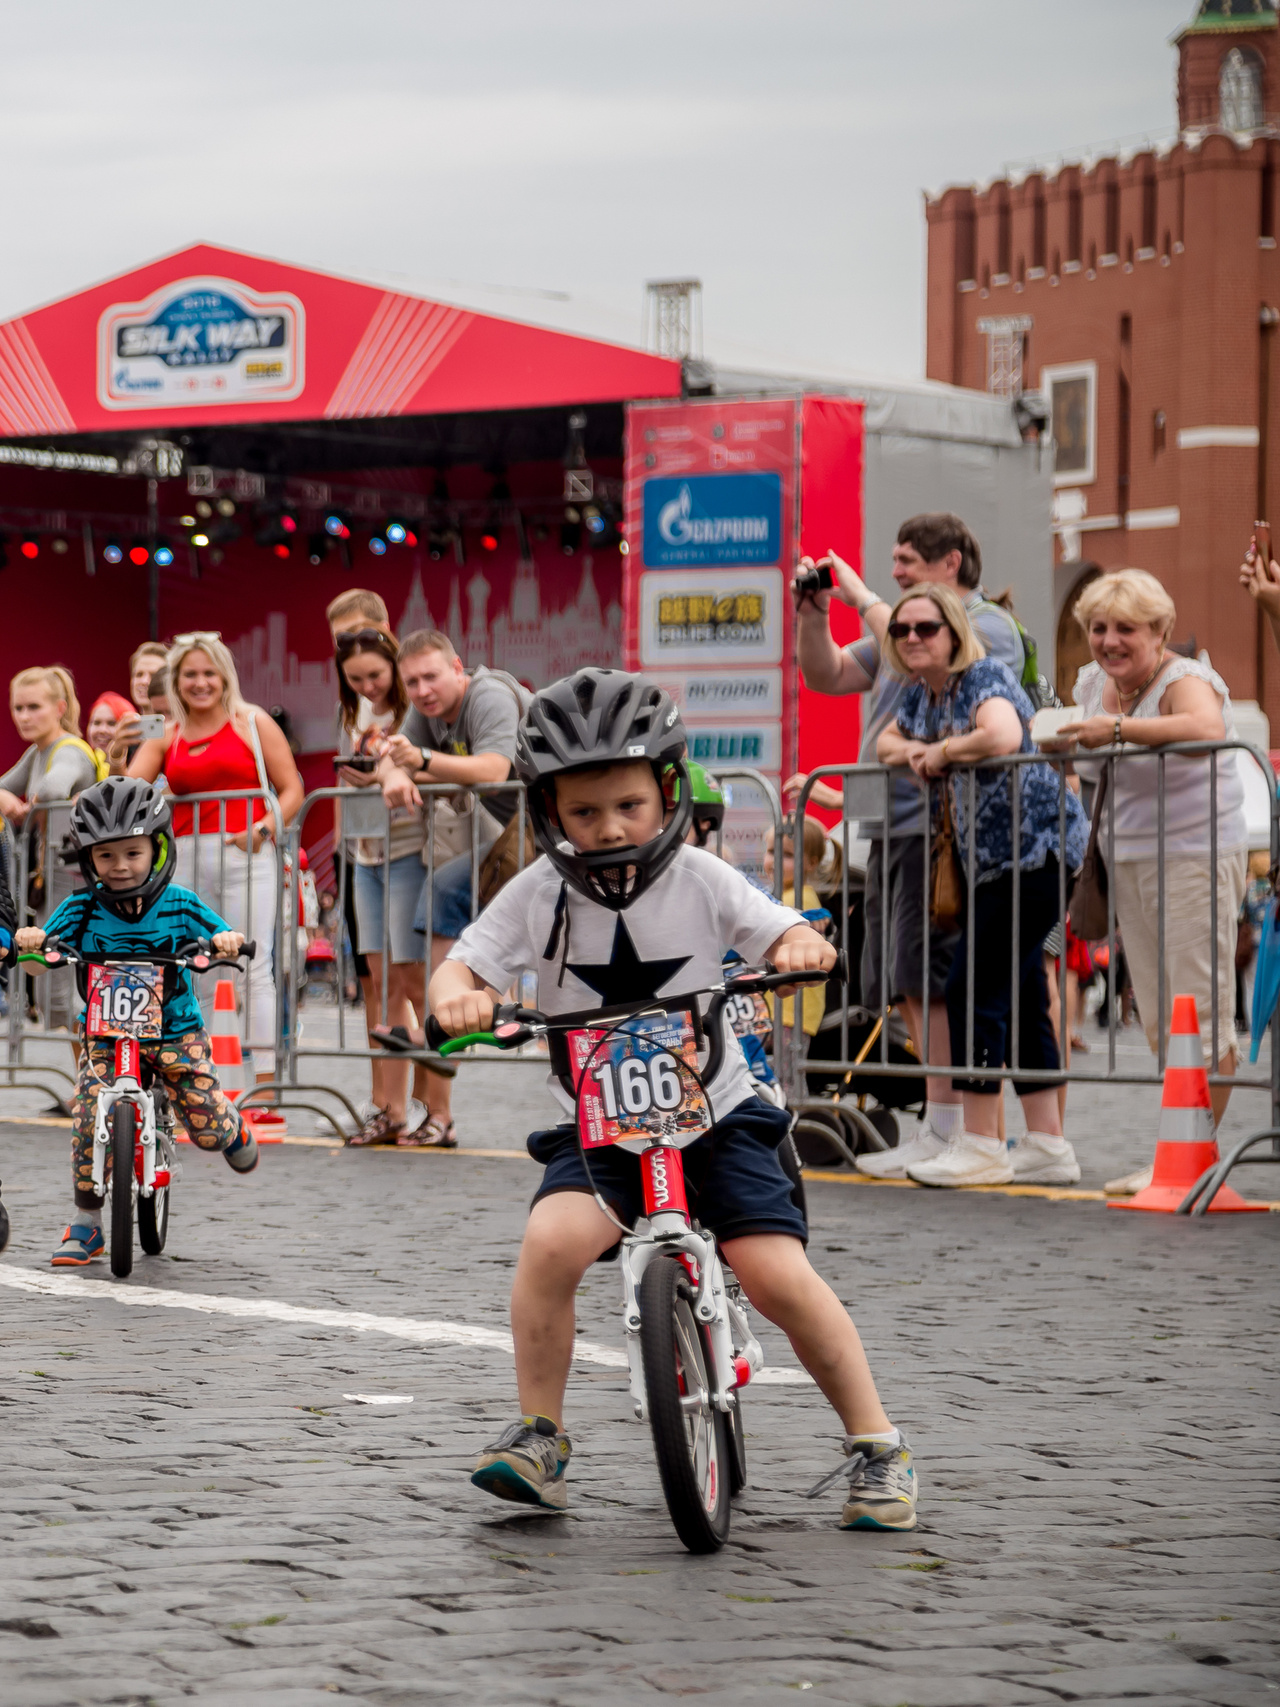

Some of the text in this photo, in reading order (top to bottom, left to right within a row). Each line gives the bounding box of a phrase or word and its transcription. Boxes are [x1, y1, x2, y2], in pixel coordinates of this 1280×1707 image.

[121, 317, 282, 356] SILK WAY
[691, 516, 769, 544] GAZPROM
[100, 986, 149, 1021] 162
[121, 1040, 130, 1075] woom
[594, 1052, 681, 1118] 166
[651, 1148, 669, 1208] woom
